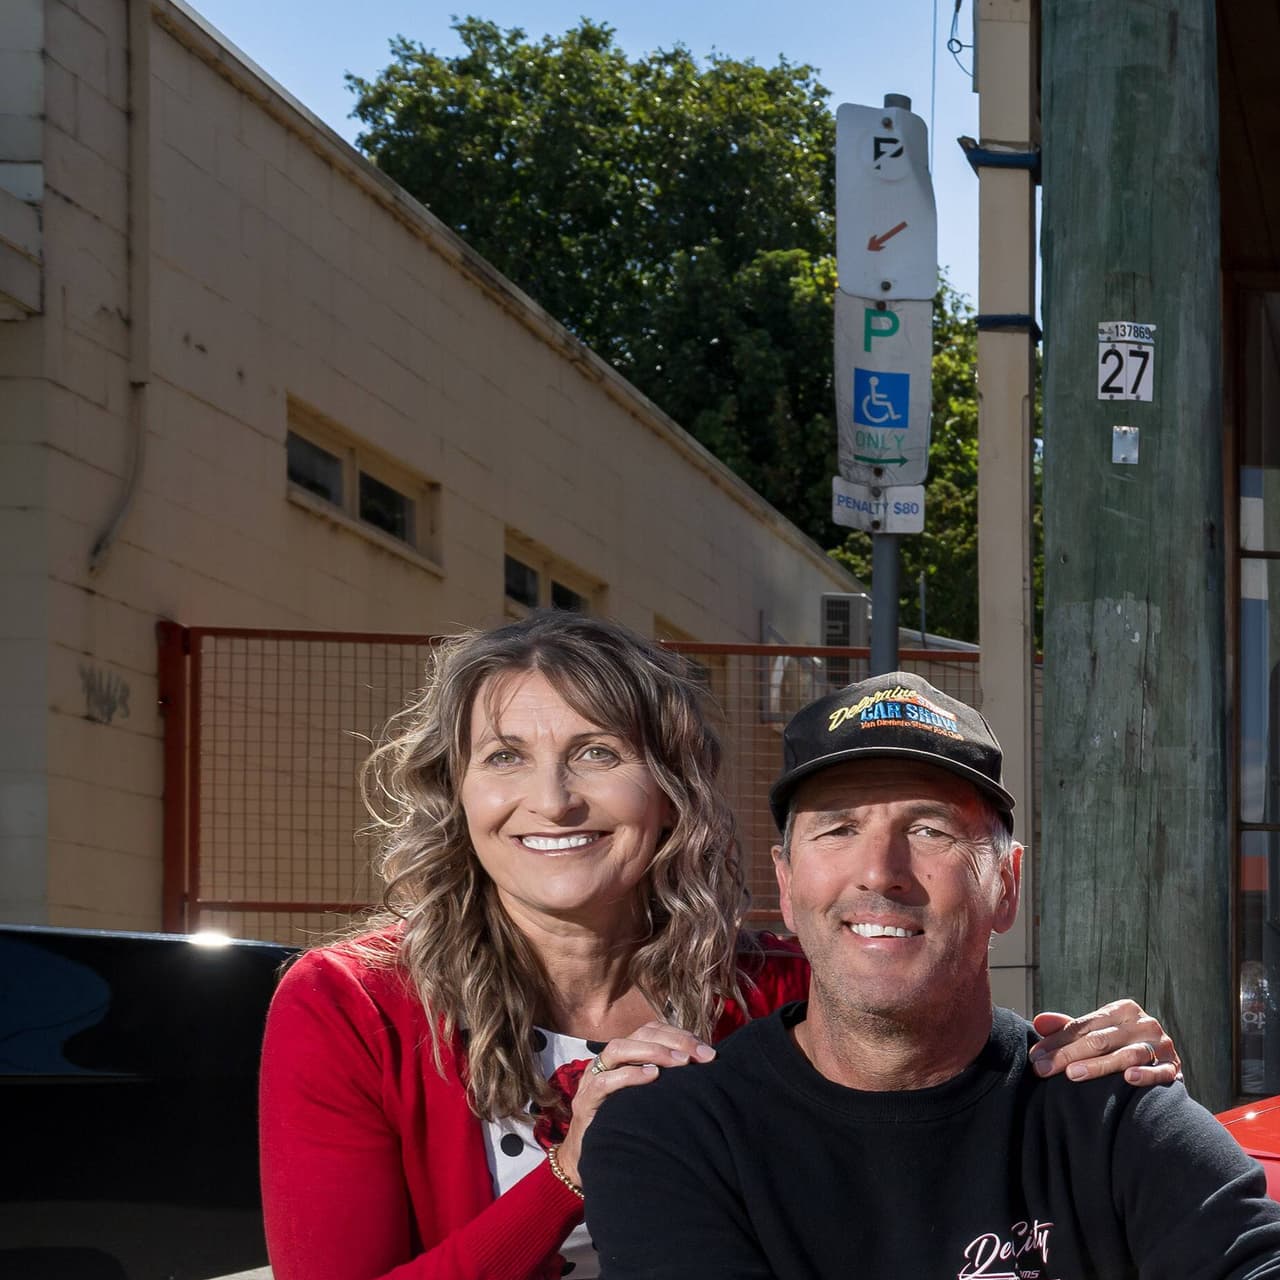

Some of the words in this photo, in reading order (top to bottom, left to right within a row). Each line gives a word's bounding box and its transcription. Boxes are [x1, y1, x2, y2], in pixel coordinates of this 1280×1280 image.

[864, 309, 899, 353] P
[1115, 324, 1153, 340] 137869
[1101, 348, 1150, 395] 27
[855, 430, 906, 449] ONLY
[837, 494, 888, 515] PENALTY
[860, 701, 903, 721] CAR
[905, 703, 959, 732] SHOW
